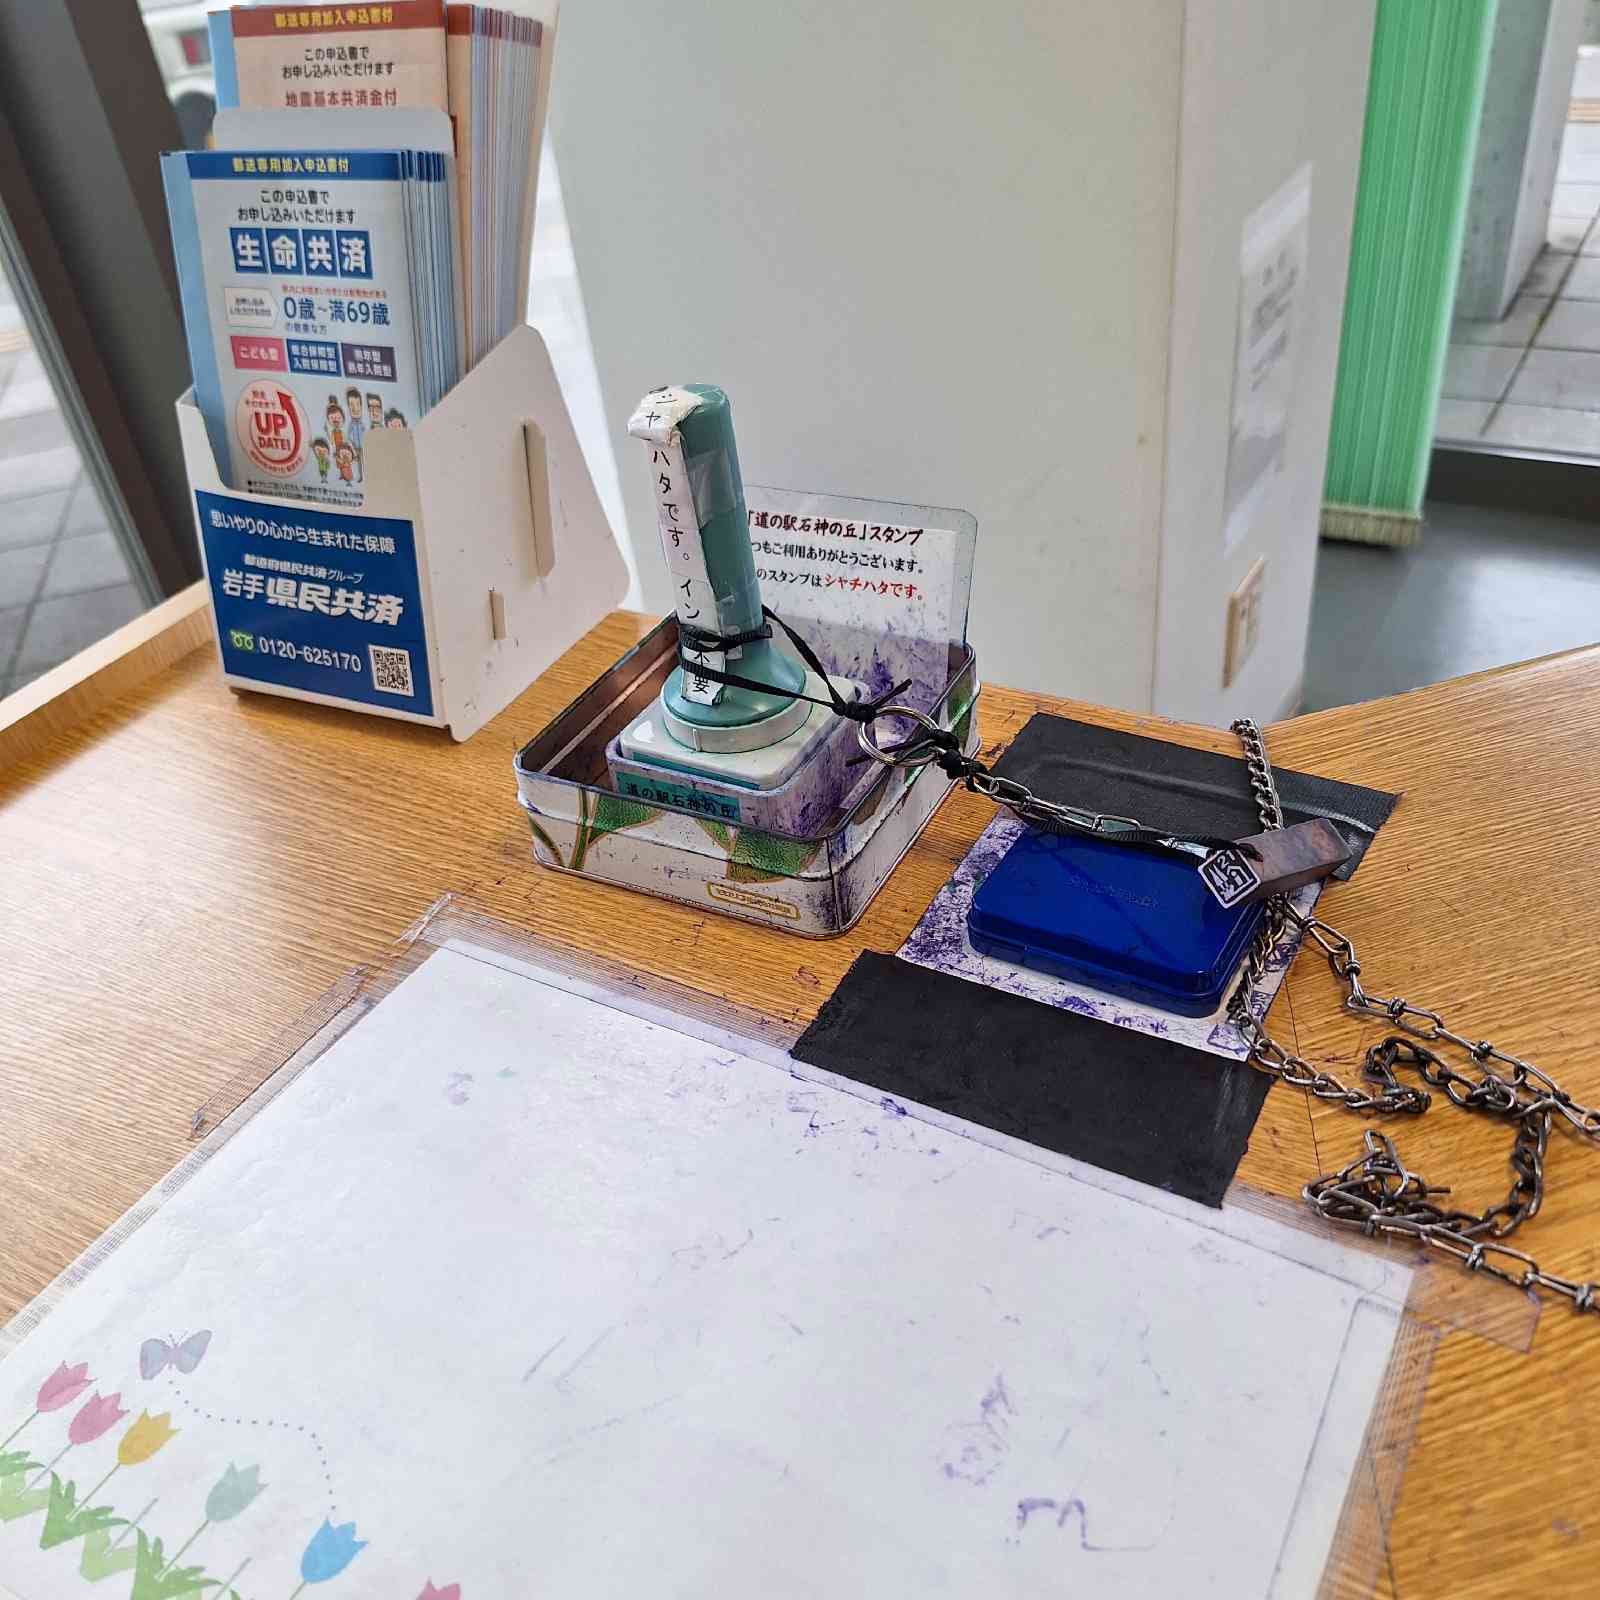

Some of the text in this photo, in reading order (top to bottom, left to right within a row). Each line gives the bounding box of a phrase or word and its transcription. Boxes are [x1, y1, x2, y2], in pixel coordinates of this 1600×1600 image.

[304, 46, 370, 61] この申込書で
[282, 62, 395, 80] お申し込みいただけます
[260, 189, 330, 205] この申込書で
[237, 207, 356, 224] お申し込みいただけます
[236, 234, 368, 274] 生命共済
[254, 411, 288, 435] UP
[210, 509, 397, 555] 思いやりの心から生まれた保障
[243, 553, 365, 584] 都道府県民共済グループ
[751, 541, 924, 574] つもご利用ありがとうございます。
[222, 568, 404, 626] 岩手県民共済
[756, 568, 923, 601] のスタンプはシャチハタです。
[258, 637, 362, 673] 0120-625170
